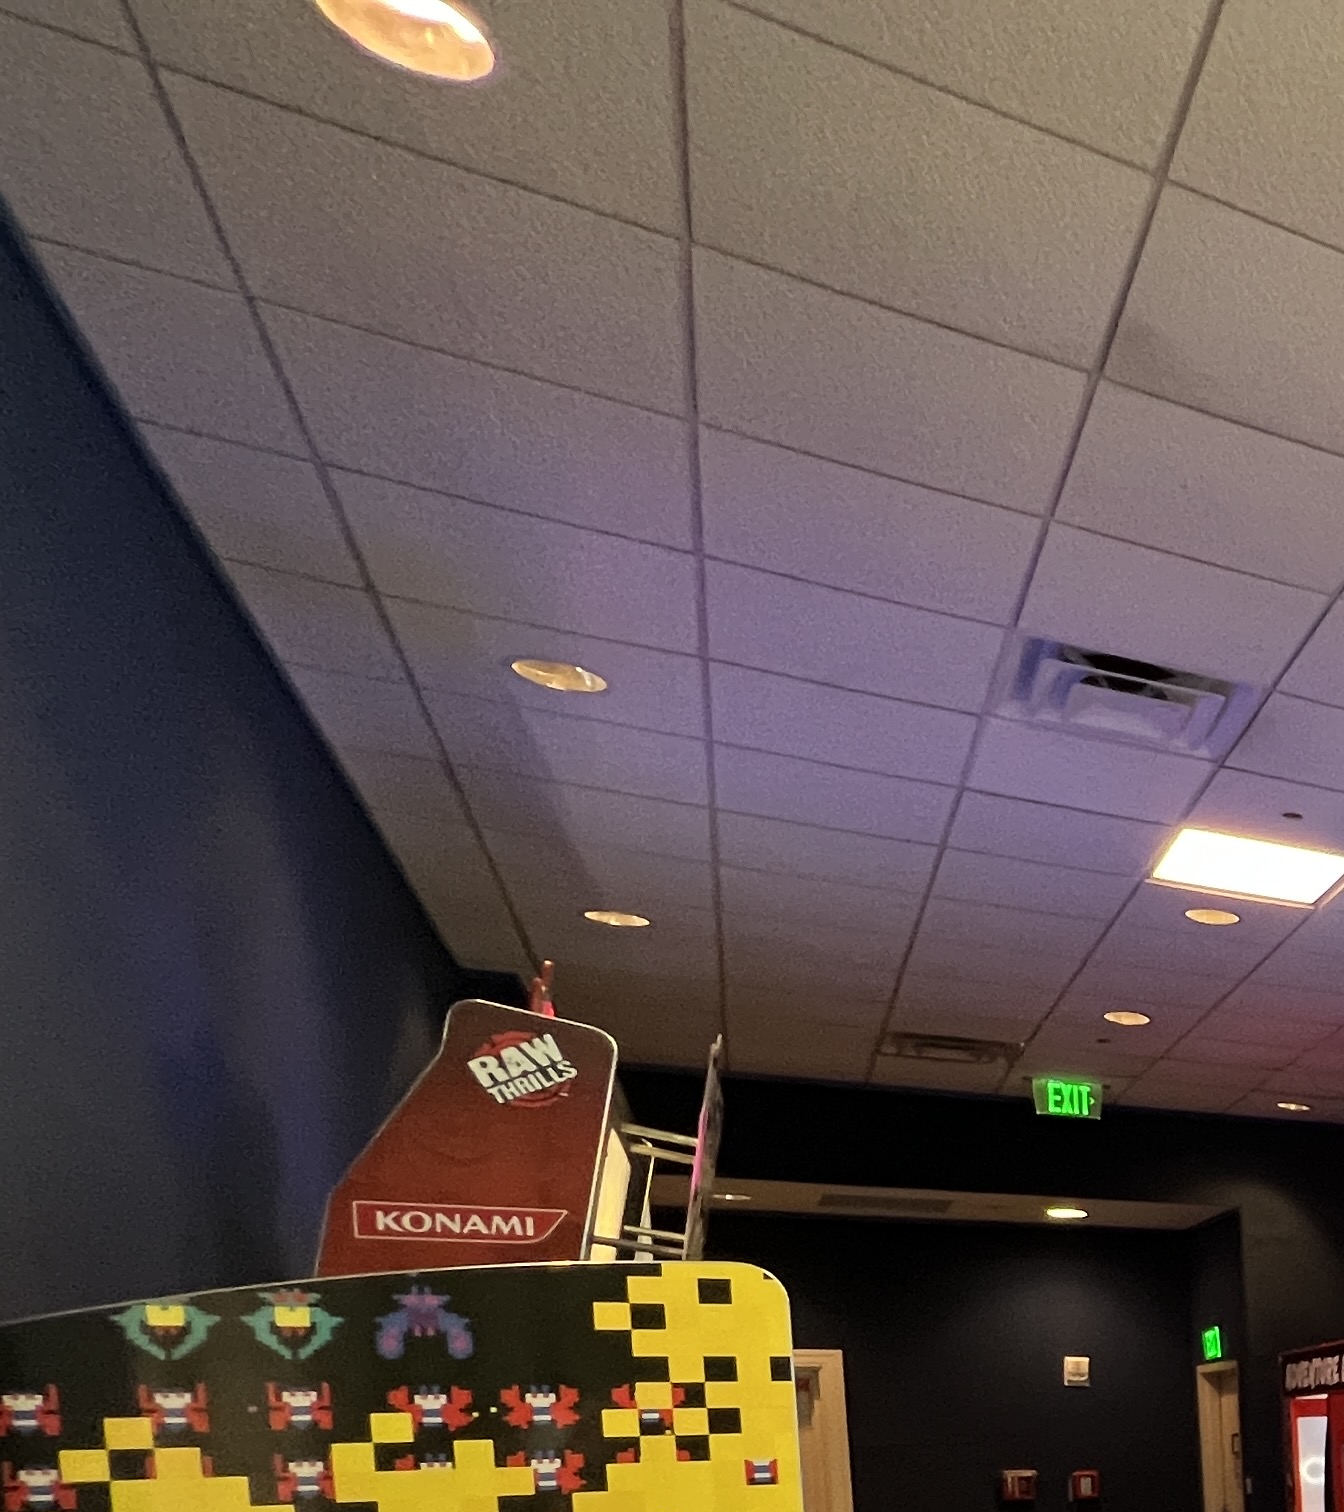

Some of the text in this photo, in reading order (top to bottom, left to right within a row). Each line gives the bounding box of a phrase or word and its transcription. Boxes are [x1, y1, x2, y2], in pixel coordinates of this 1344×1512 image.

[468, 1033, 563, 1088] RAW
[487, 1060, 578, 1104] THRILLS
[1047, 1081, 1091, 1116] EXIT
[375, 1210, 535, 1237] KONAMI
